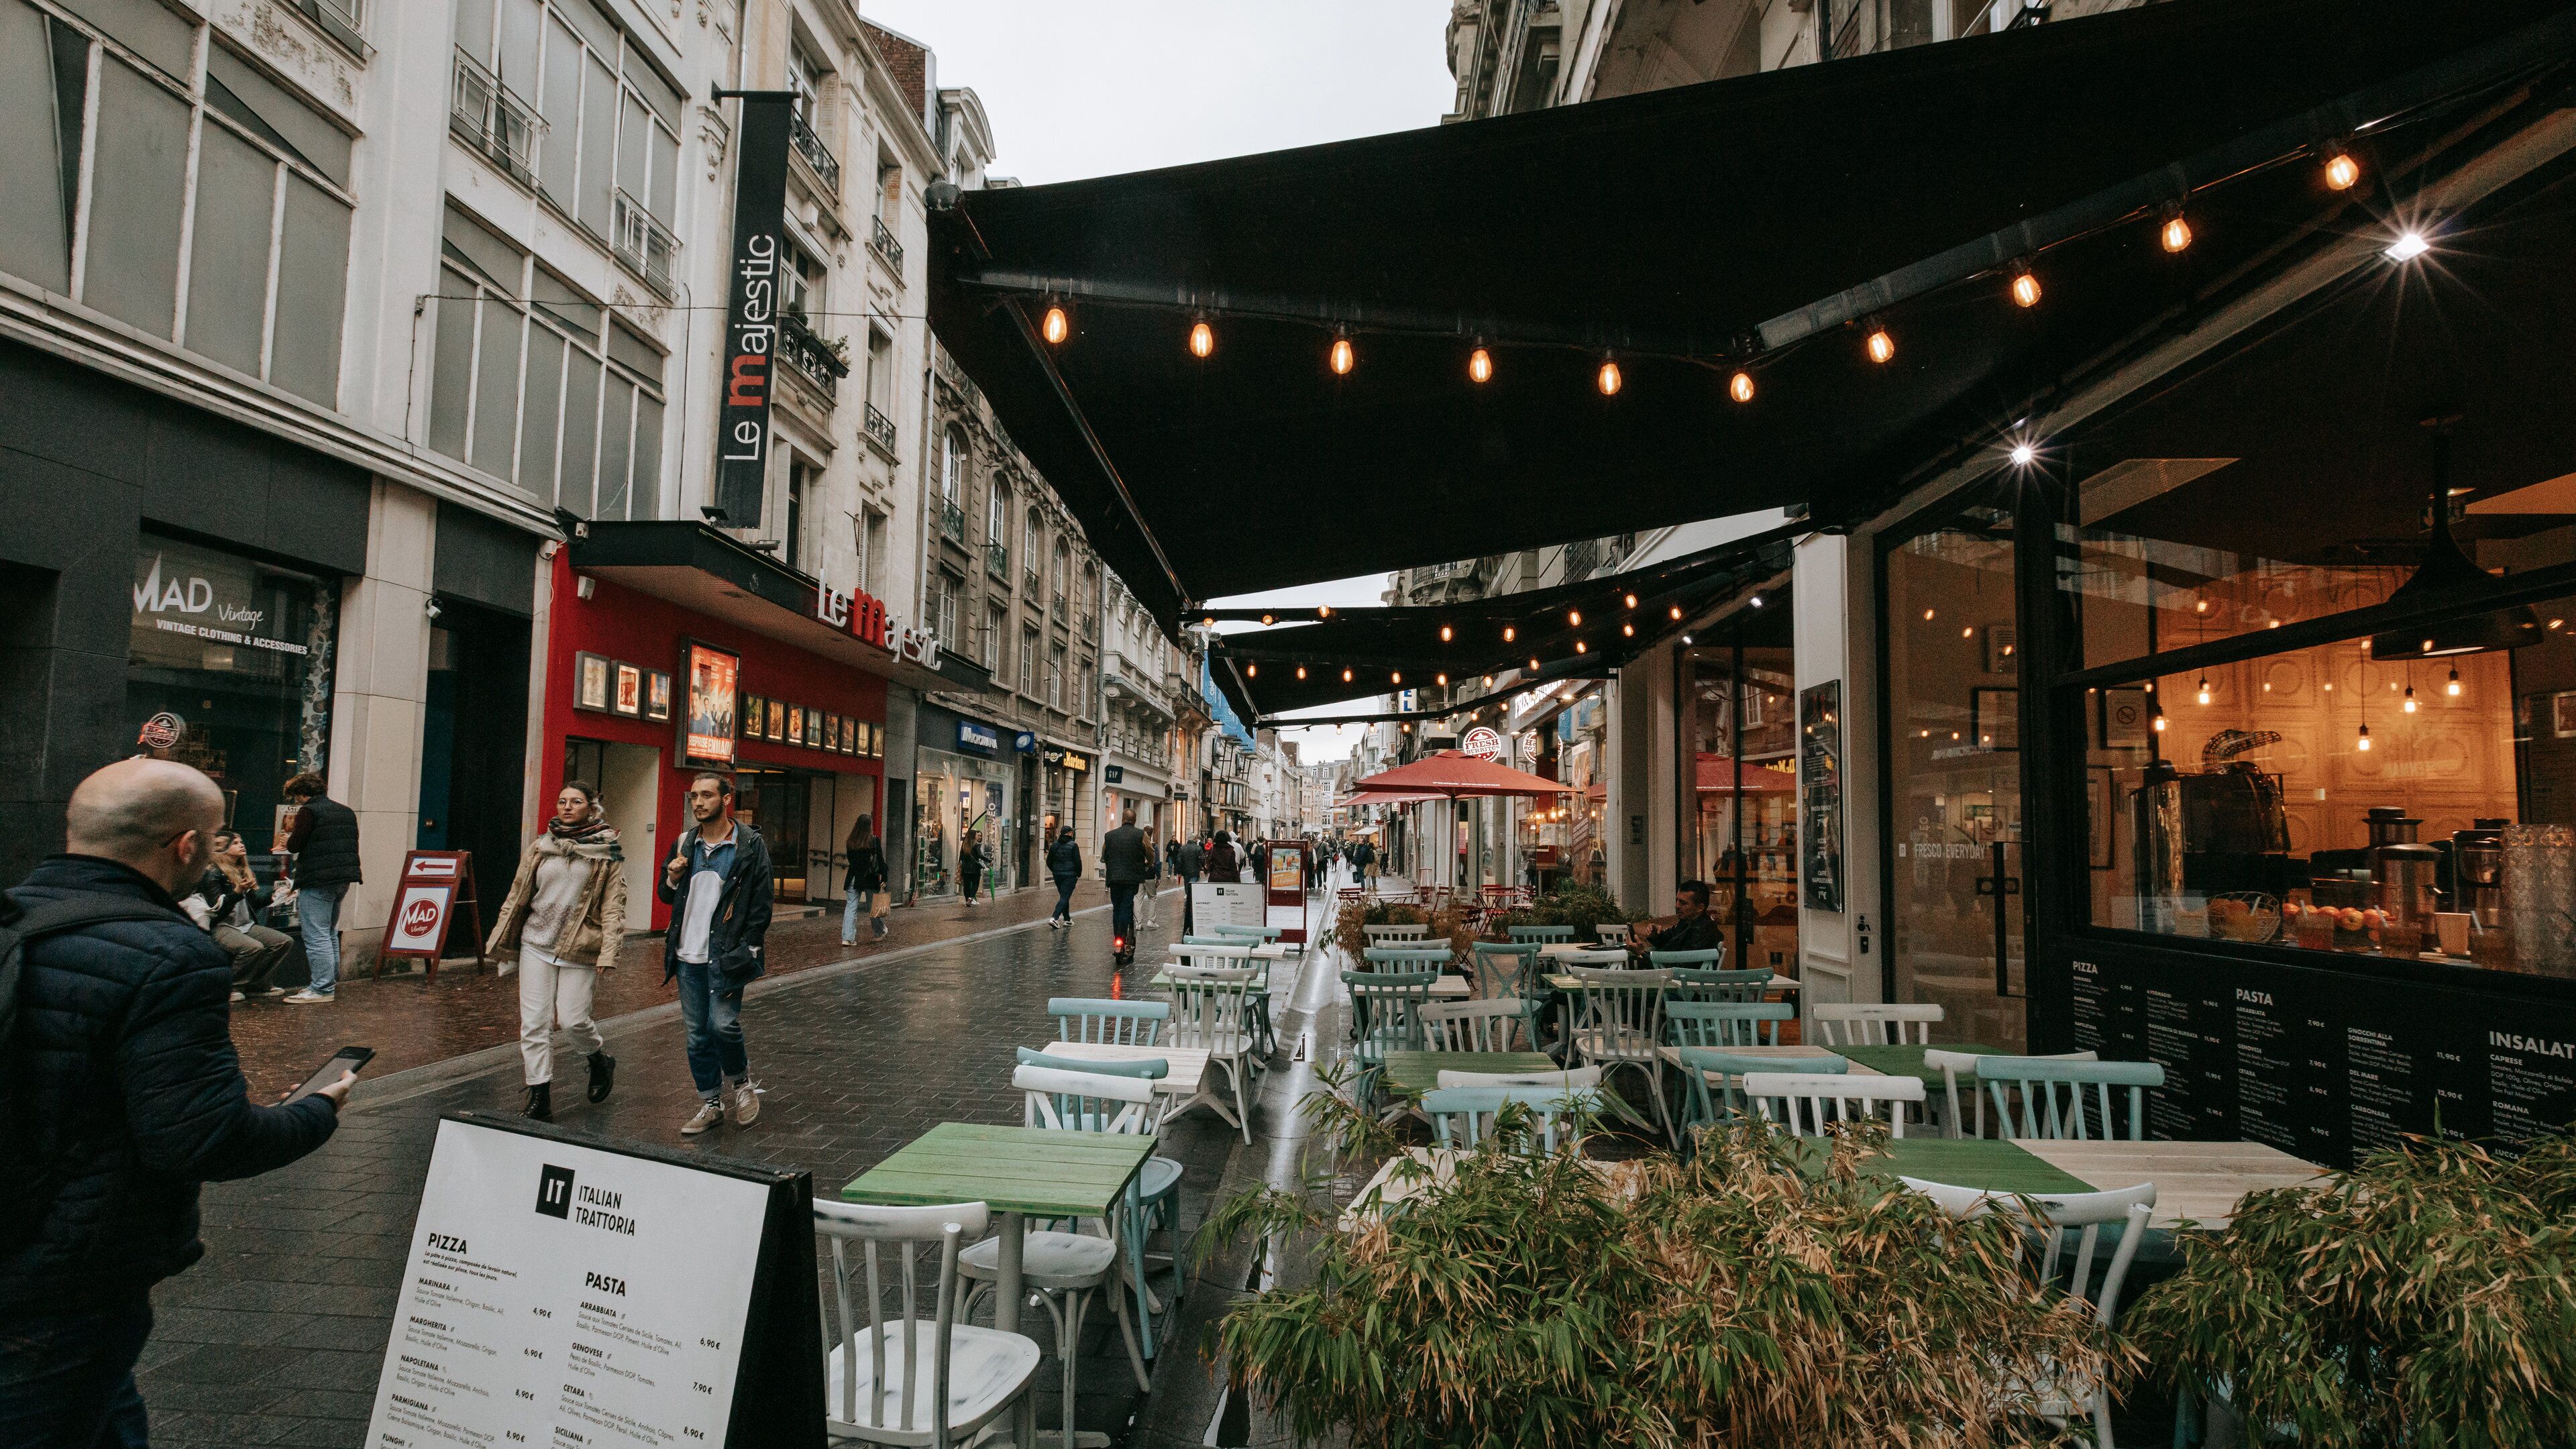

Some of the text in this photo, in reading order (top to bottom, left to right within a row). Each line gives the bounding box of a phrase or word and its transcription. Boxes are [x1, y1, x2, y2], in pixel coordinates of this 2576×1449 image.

[724, 234, 776, 462] Le majestic
[133, 552, 264, 630] MAD Vintage
[818, 569, 943, 670] Le majestic
[156, 619, 307, 655] VINTAGE CLOTHING & ACCESSORIES
[1465, 739, 1499, 749] FRESH
[1466, 745, 1500, 755] BURRITOS
[1109, 770, 1118, 778] GAP
[1915, 843, 1985, 859] FRESCO EVERYDAY
[402, 902, 436, 930] MAD
[2073, 961, 2098, 974] PIZZA
[2236, 988, 2273, 1006] PASTA
[2347, 1028, 2376, 1037] GNOCCHI
[2348, 1034, 2387, 1047] SORRENTINA
[2237, 1044, 2262, 1054] GENOVESE
[2490, 1054, 2523, 1066] CAPRESE
[2361, 1072, 2379, 1081] MARE
[2351, 1104, 2390, 1119] CARBONARA
[2493, 1101, 2529, 1115] ROMANA
[2495, 1148, 2519, 1160] LUCCA
[546, 1179, 565, 1203] IT
[578, 1185, 622, 1210] ITALIAN
[576, 1207, 635, 1236] TRATTORIA
[428, 1233, 467, 1254] PIZZA
[456, 1266, 468, 1274] place,
[485, 1273, 498, 1281] jours.
[459, 1259, 481, 1268] composée
[488, 1265, 501, 1273] levain
[419, 1277, 451, 1291] MARINARA
[586, 1271, 626, 1297] PASTA
[580, 1301, 616, 1318] ARRABBIATA
[410, 1316, 446, 1332] MARGHERITA
[572, 1342, 603, 1358] GENOVESE
[400, 1354, 439, 1371] NAPOLETANA
[564, 1384, 585, 1397] CETARA
[392, 1393, 429, 1411] PARMIGIANA
[382, 1433, 405, 1446] FUNGHI
[555, 1426, 583, 1443] SICILIANA
